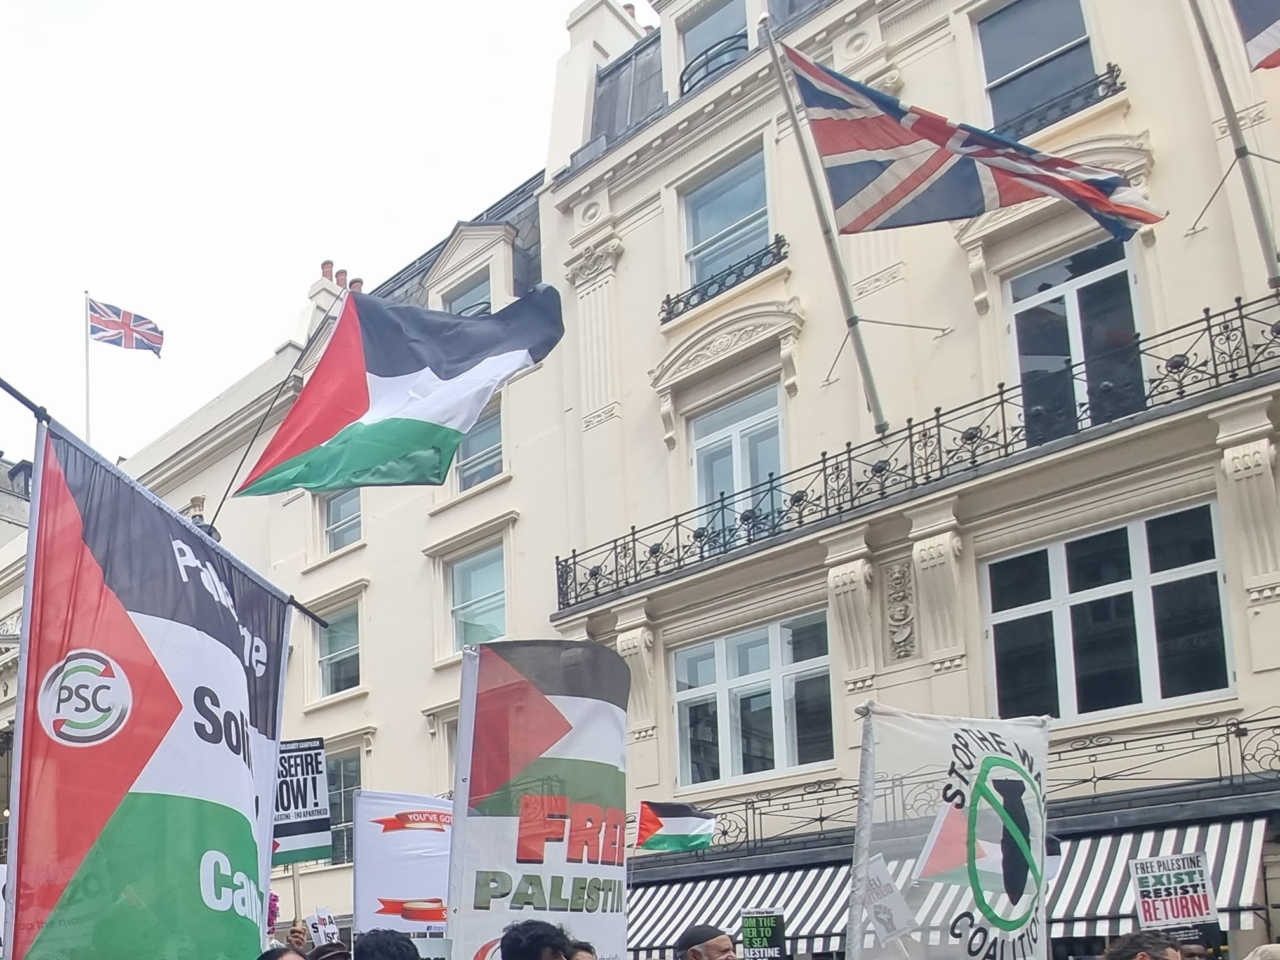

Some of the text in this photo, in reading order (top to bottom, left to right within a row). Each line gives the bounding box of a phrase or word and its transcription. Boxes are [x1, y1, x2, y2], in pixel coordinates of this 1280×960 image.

[56, 684, 112, 713] PSC
[278, 752, 323, 779] SEFIRE
[275, 776, 319, 812] OW!
[1135, 855, 1202, 875] FREE PALESTINE
[1137, 869, 1204, 889] EXIST!
[1140, 883, 1206, 899] RESIST!
[1141, 893, 1210, 923] RETURN!
